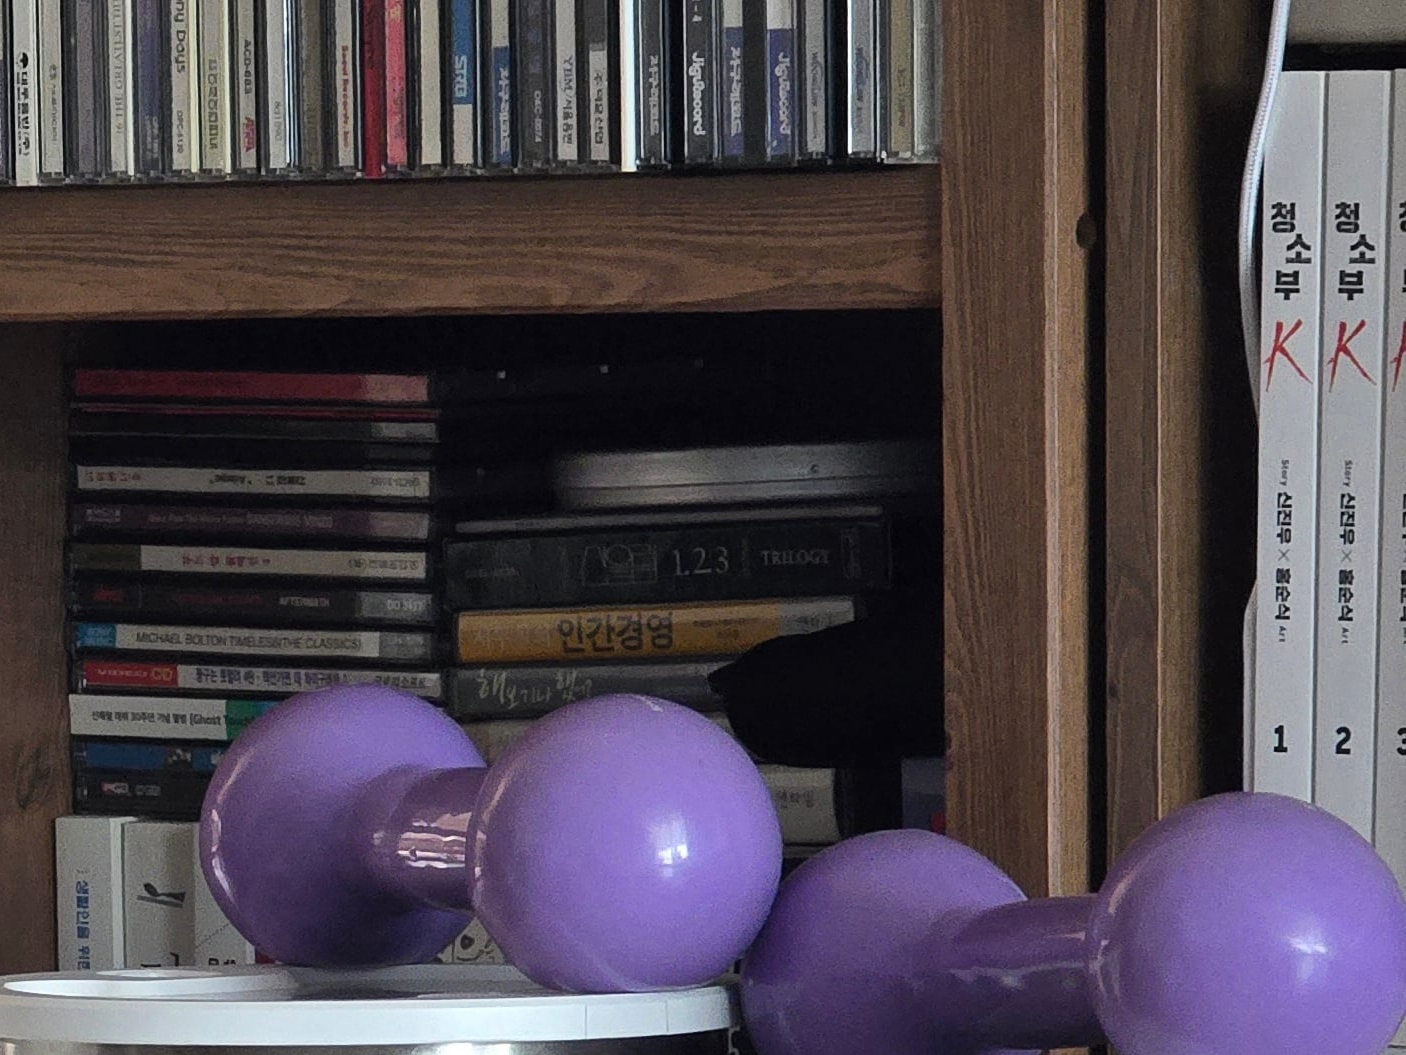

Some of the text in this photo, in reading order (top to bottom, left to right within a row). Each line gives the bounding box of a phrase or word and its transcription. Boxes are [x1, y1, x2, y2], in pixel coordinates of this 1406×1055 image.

[113, 22, 123, 90] GREATEST
[174, 0, 187, 73] ny Days
[114, 93, 123, 118] THE
[1271, 202, 1312, 301] 청소부
[1335, 202, 1376, 301] 청소부
[1263, 319, 1313, 392] K
[1327, 319, 1377, 392] K
[1280, 459, 1289, 487] Story
[1343, 460, 1353, 488] Story
[1276, 491, 1292, 545] 신진우
[1340, 492, 1355, 545] 신진우
[759, 548, 830, 567] TRILOGY
[1275, 567, 1291, 621] 홍순식
[1338, 569, 1354, 622] 홍순식
[136, 631, 182, 646] MICHAEL
[185, 633, 228, 647] BOLTON
[305, 636, 361, 651] CLASSICS)
[556, 611, 675, 654] 인간경영
[1279, 626, 1287, 643] Art
[1341, 627, 1349, 644] Art
[1273, 725, 1288, 753] 1
[1335, 726, 1352, 755] 2
